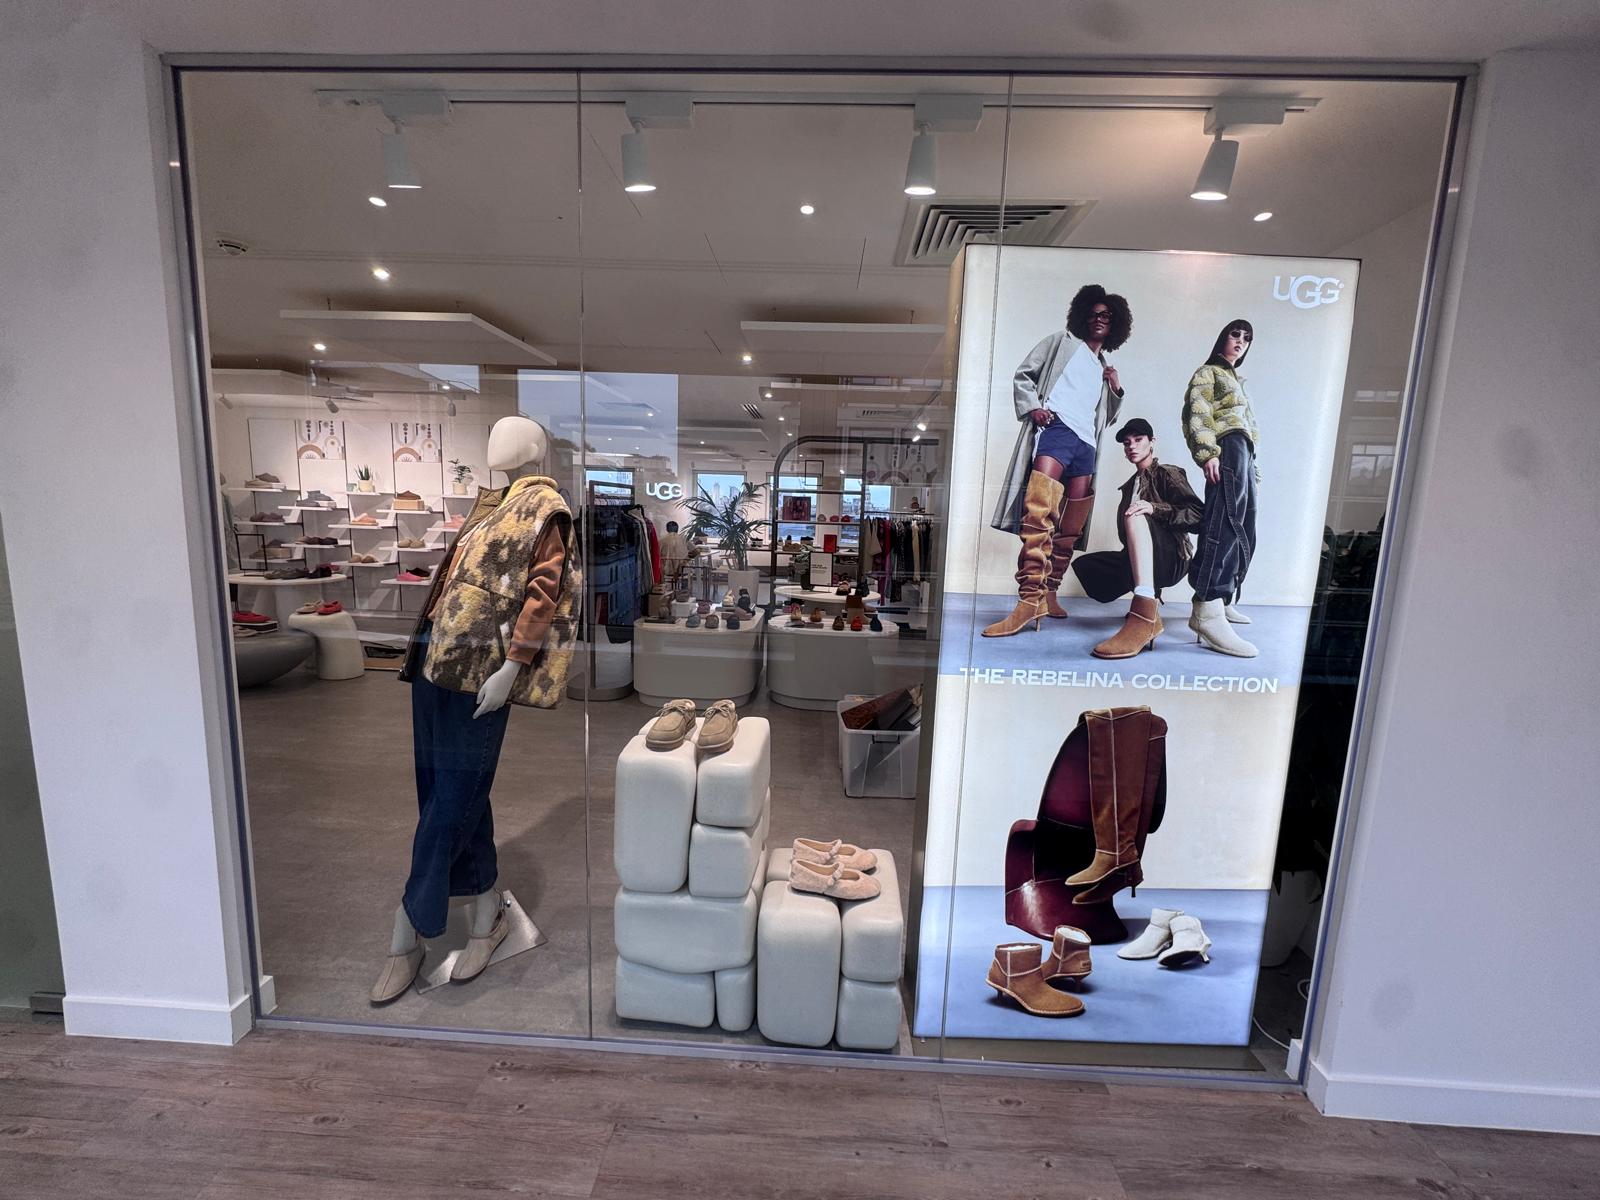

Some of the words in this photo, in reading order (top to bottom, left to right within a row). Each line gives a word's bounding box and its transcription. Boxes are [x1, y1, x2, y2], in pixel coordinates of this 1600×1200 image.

[1273, 274, 1341, 309] UGG
[645, 481, 683, 501] UGG
[959, 667, 1005, 685] THE
[1012, 669, 1125, 689] REBELINA
[1131, 673, 1279, 694] COLLECTION
